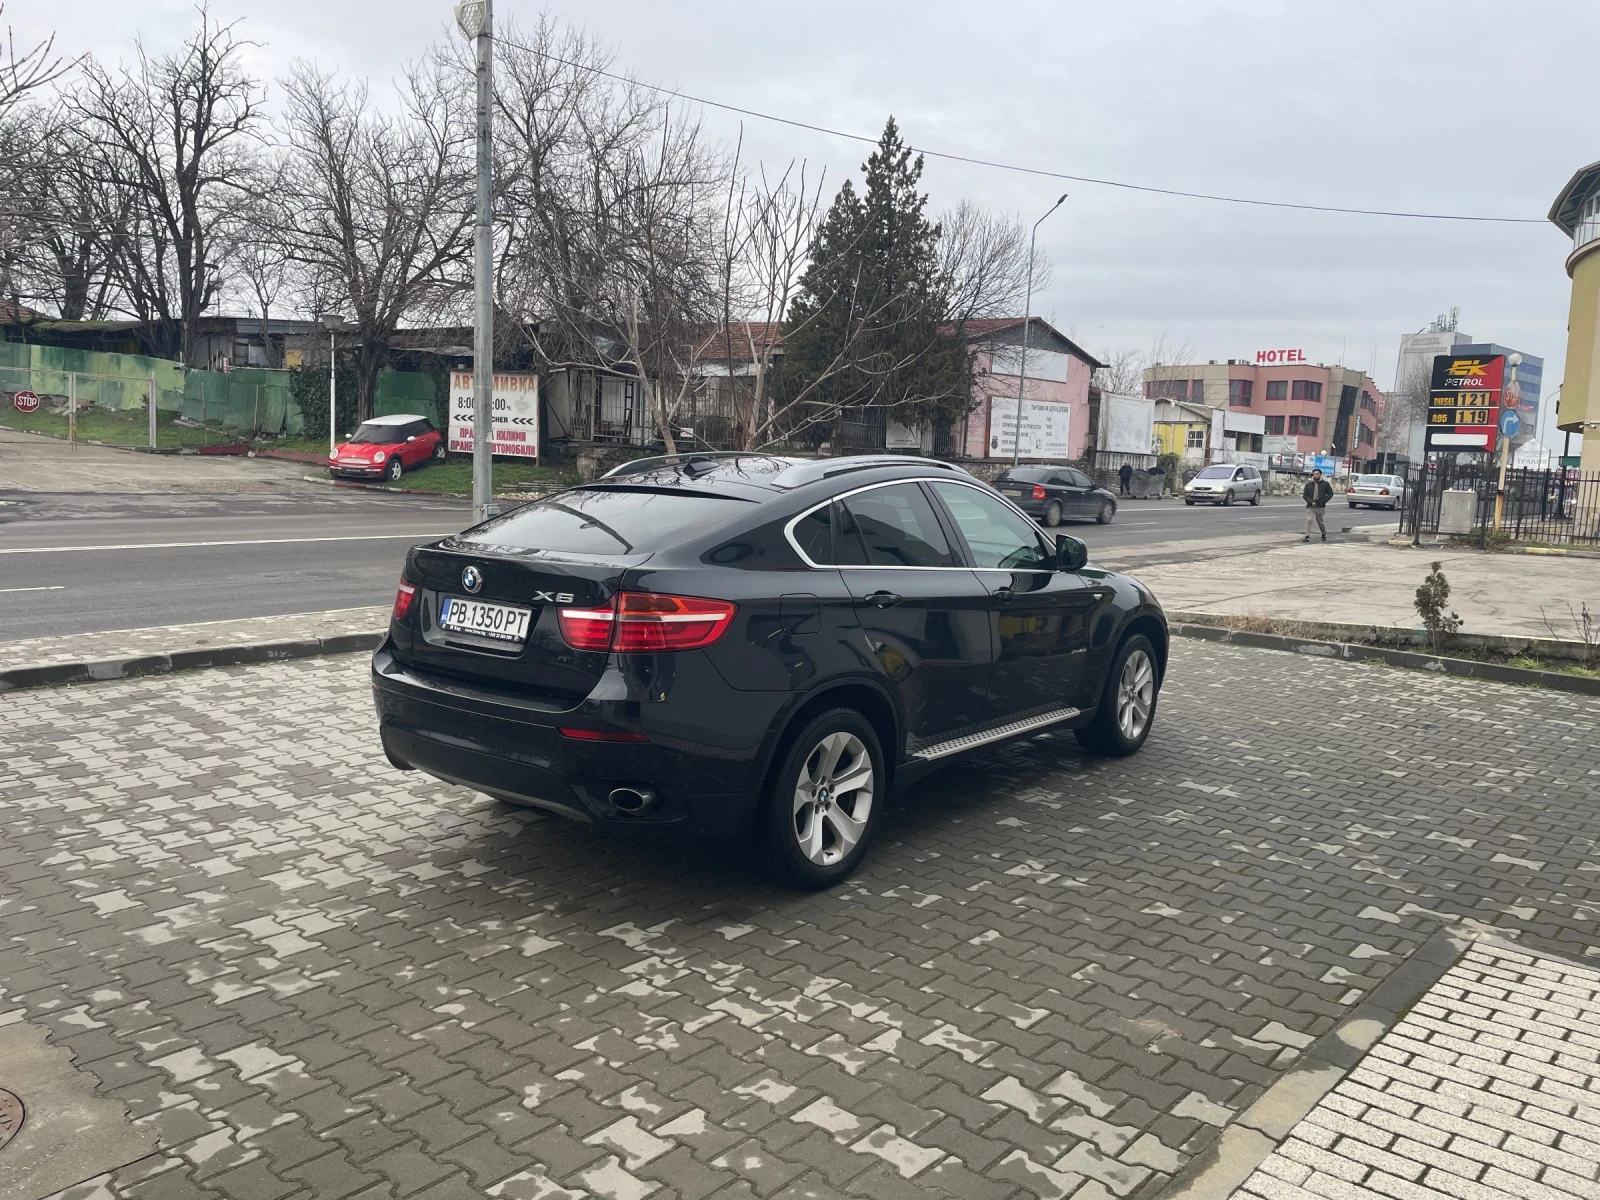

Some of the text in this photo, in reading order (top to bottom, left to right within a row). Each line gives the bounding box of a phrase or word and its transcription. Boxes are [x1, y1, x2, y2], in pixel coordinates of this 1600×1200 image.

[1256, 349, 1307, 363] HOTEL
[453, 375, 535, 392] АВМИВКА
[1444, 378, 1484, 386] PETROL
[17, 396, 37, 407] STOP
[1433, 392, 1487, 406] DIESEL 1.21
[1431, 410, 1486, 423] A95 1.19
[460, 428, 474, 439] ПРА
[451, 440, 536, 456] ПРАНЕ ВТОМОБИЛИ
[532, 590, 575, 604] X6
[471, 605, 503, 630] 1350
